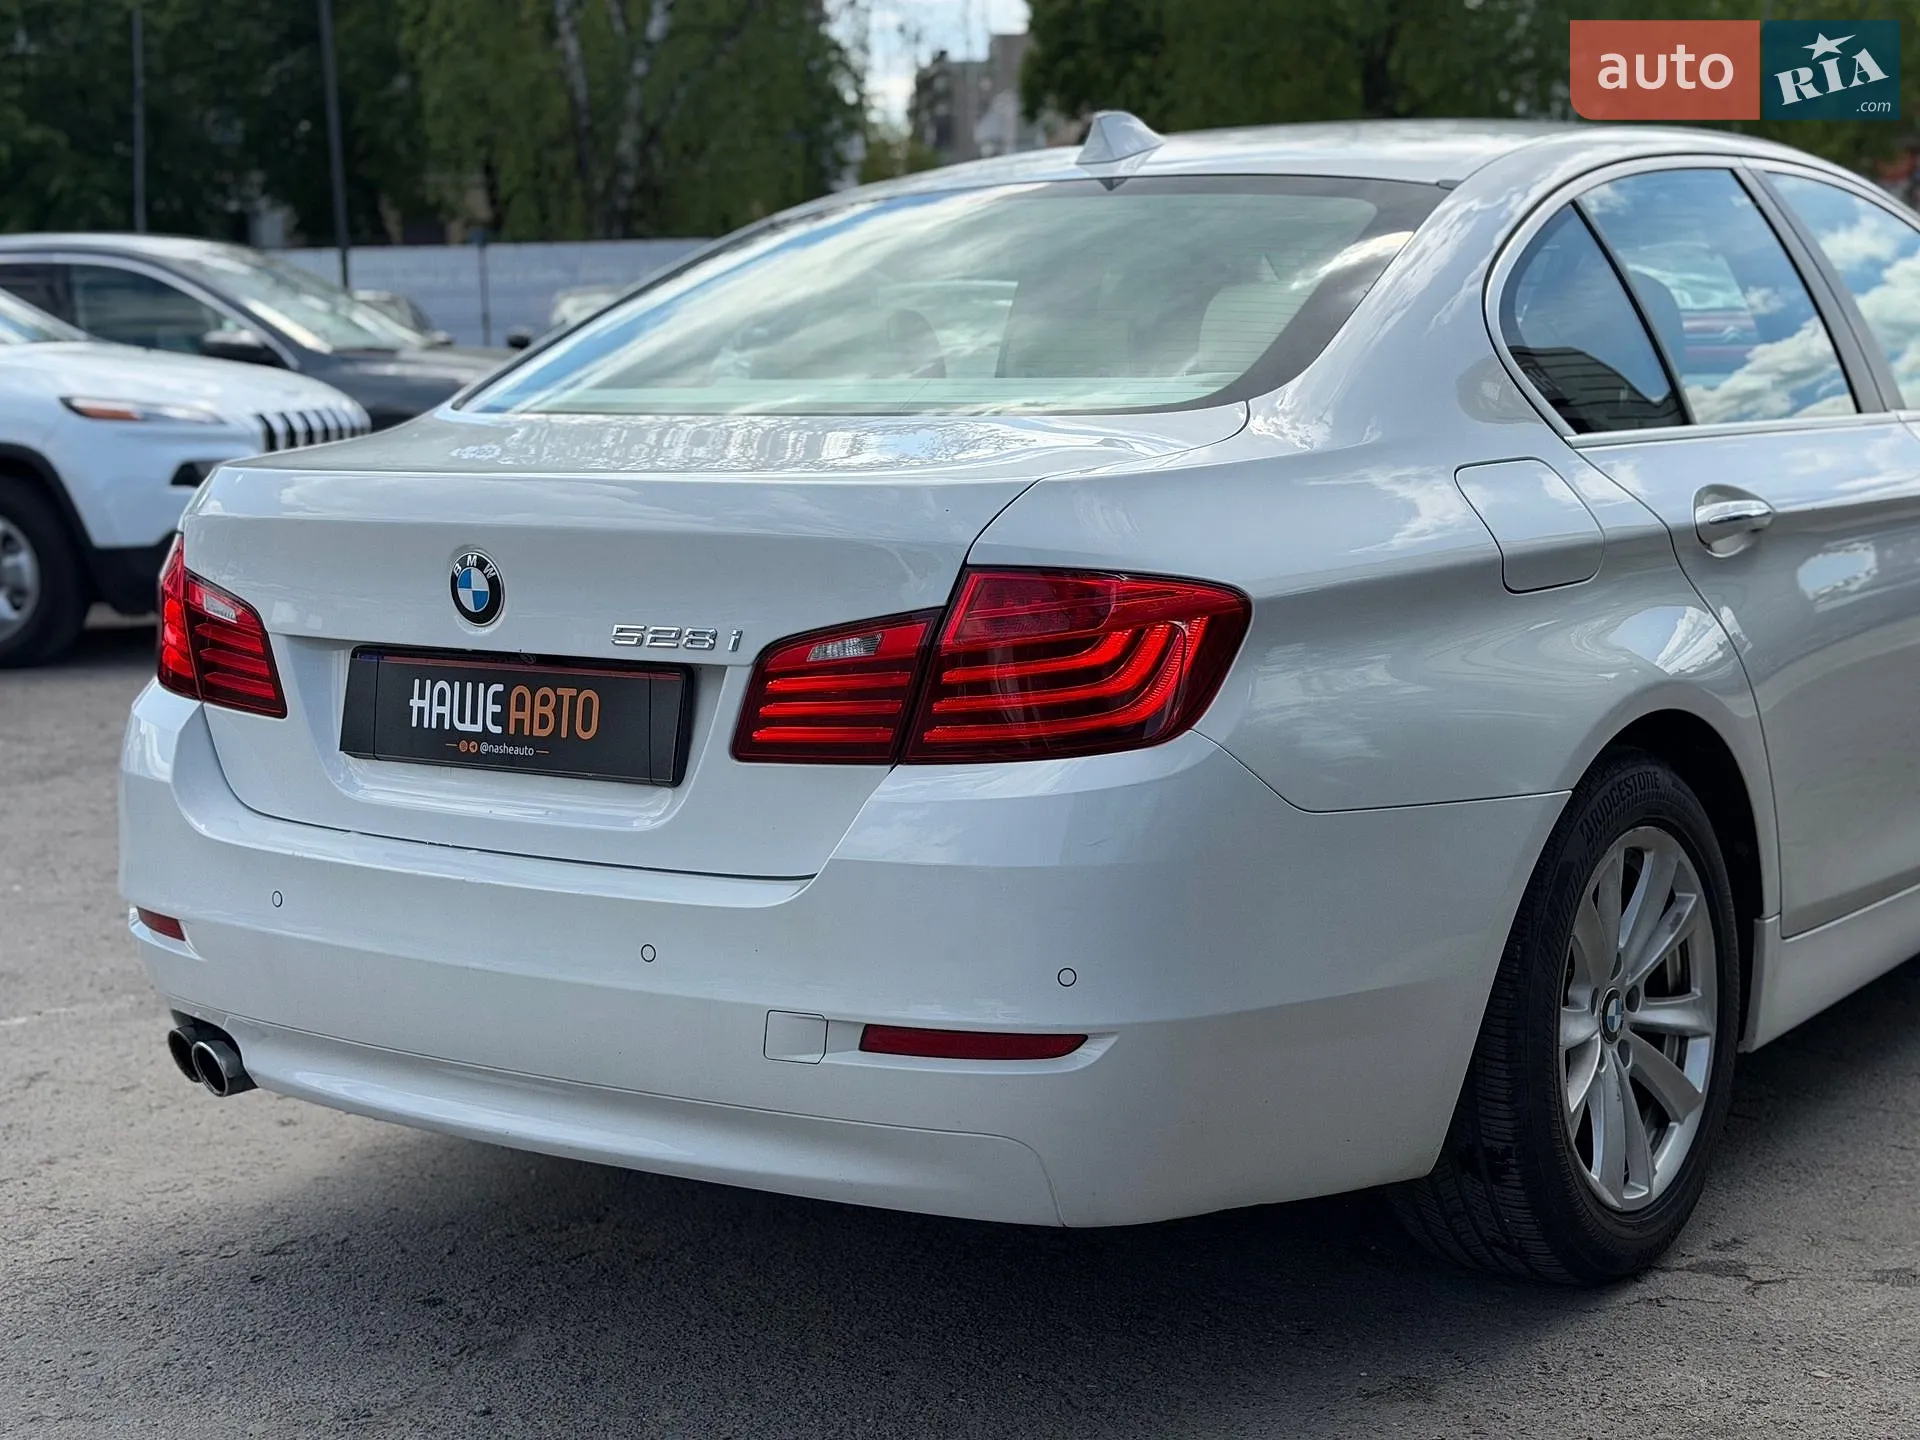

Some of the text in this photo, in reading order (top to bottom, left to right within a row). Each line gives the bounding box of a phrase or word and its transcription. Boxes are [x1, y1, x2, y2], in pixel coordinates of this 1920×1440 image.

[453, 554, 497, 580] BMW
[409, 678, 600, 740] НАШЕ АВТО
[480, 742, 534, 757] @nasheauto
[1578, 771, 1661, 845] BRIDGESTONE
